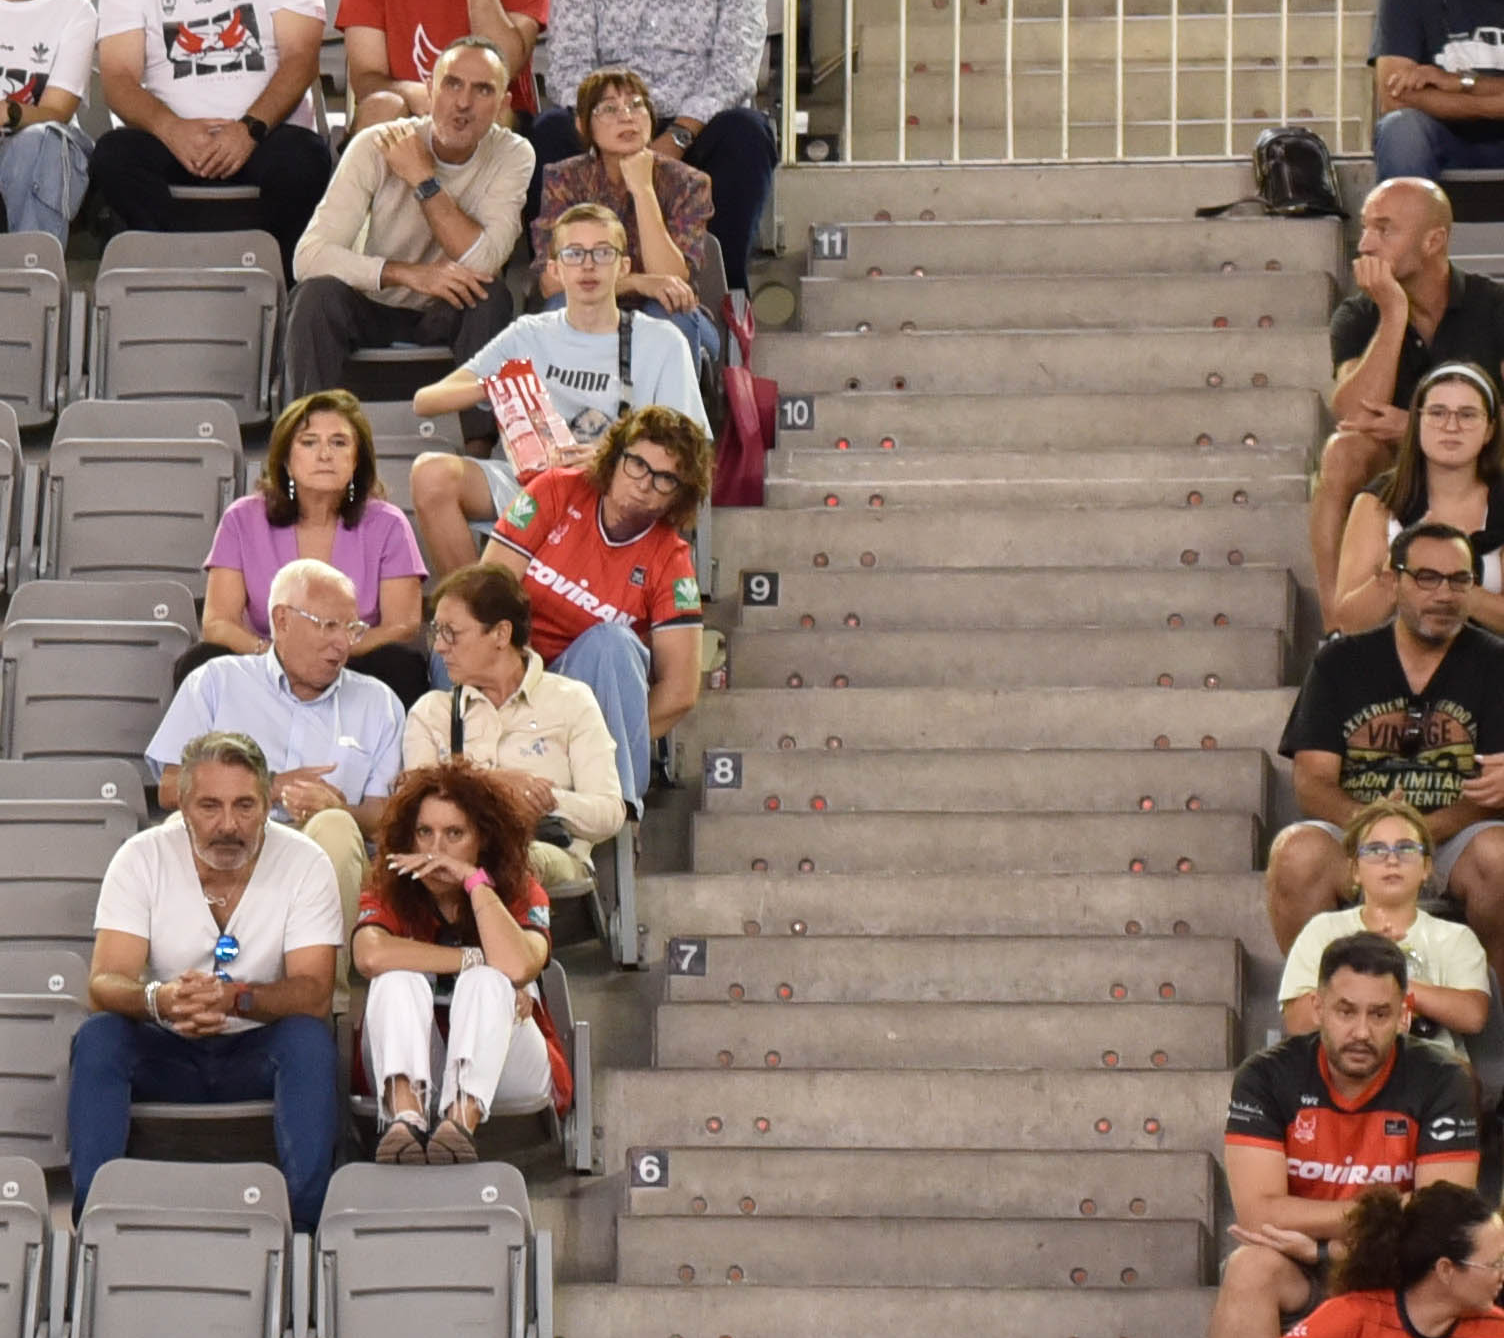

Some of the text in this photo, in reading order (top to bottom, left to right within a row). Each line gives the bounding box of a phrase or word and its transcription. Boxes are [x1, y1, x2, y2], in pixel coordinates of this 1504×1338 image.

[818, 232, 843, 256] 11
[545, 364, 610, 392] PUMA
[783, 400, 809, 426] 10
[749, 575, 771, 602] 9
[713, 757, 735, 784] 8
[679, 944, 698, 972] 7
[639, 1155, 661, 1184] 6
